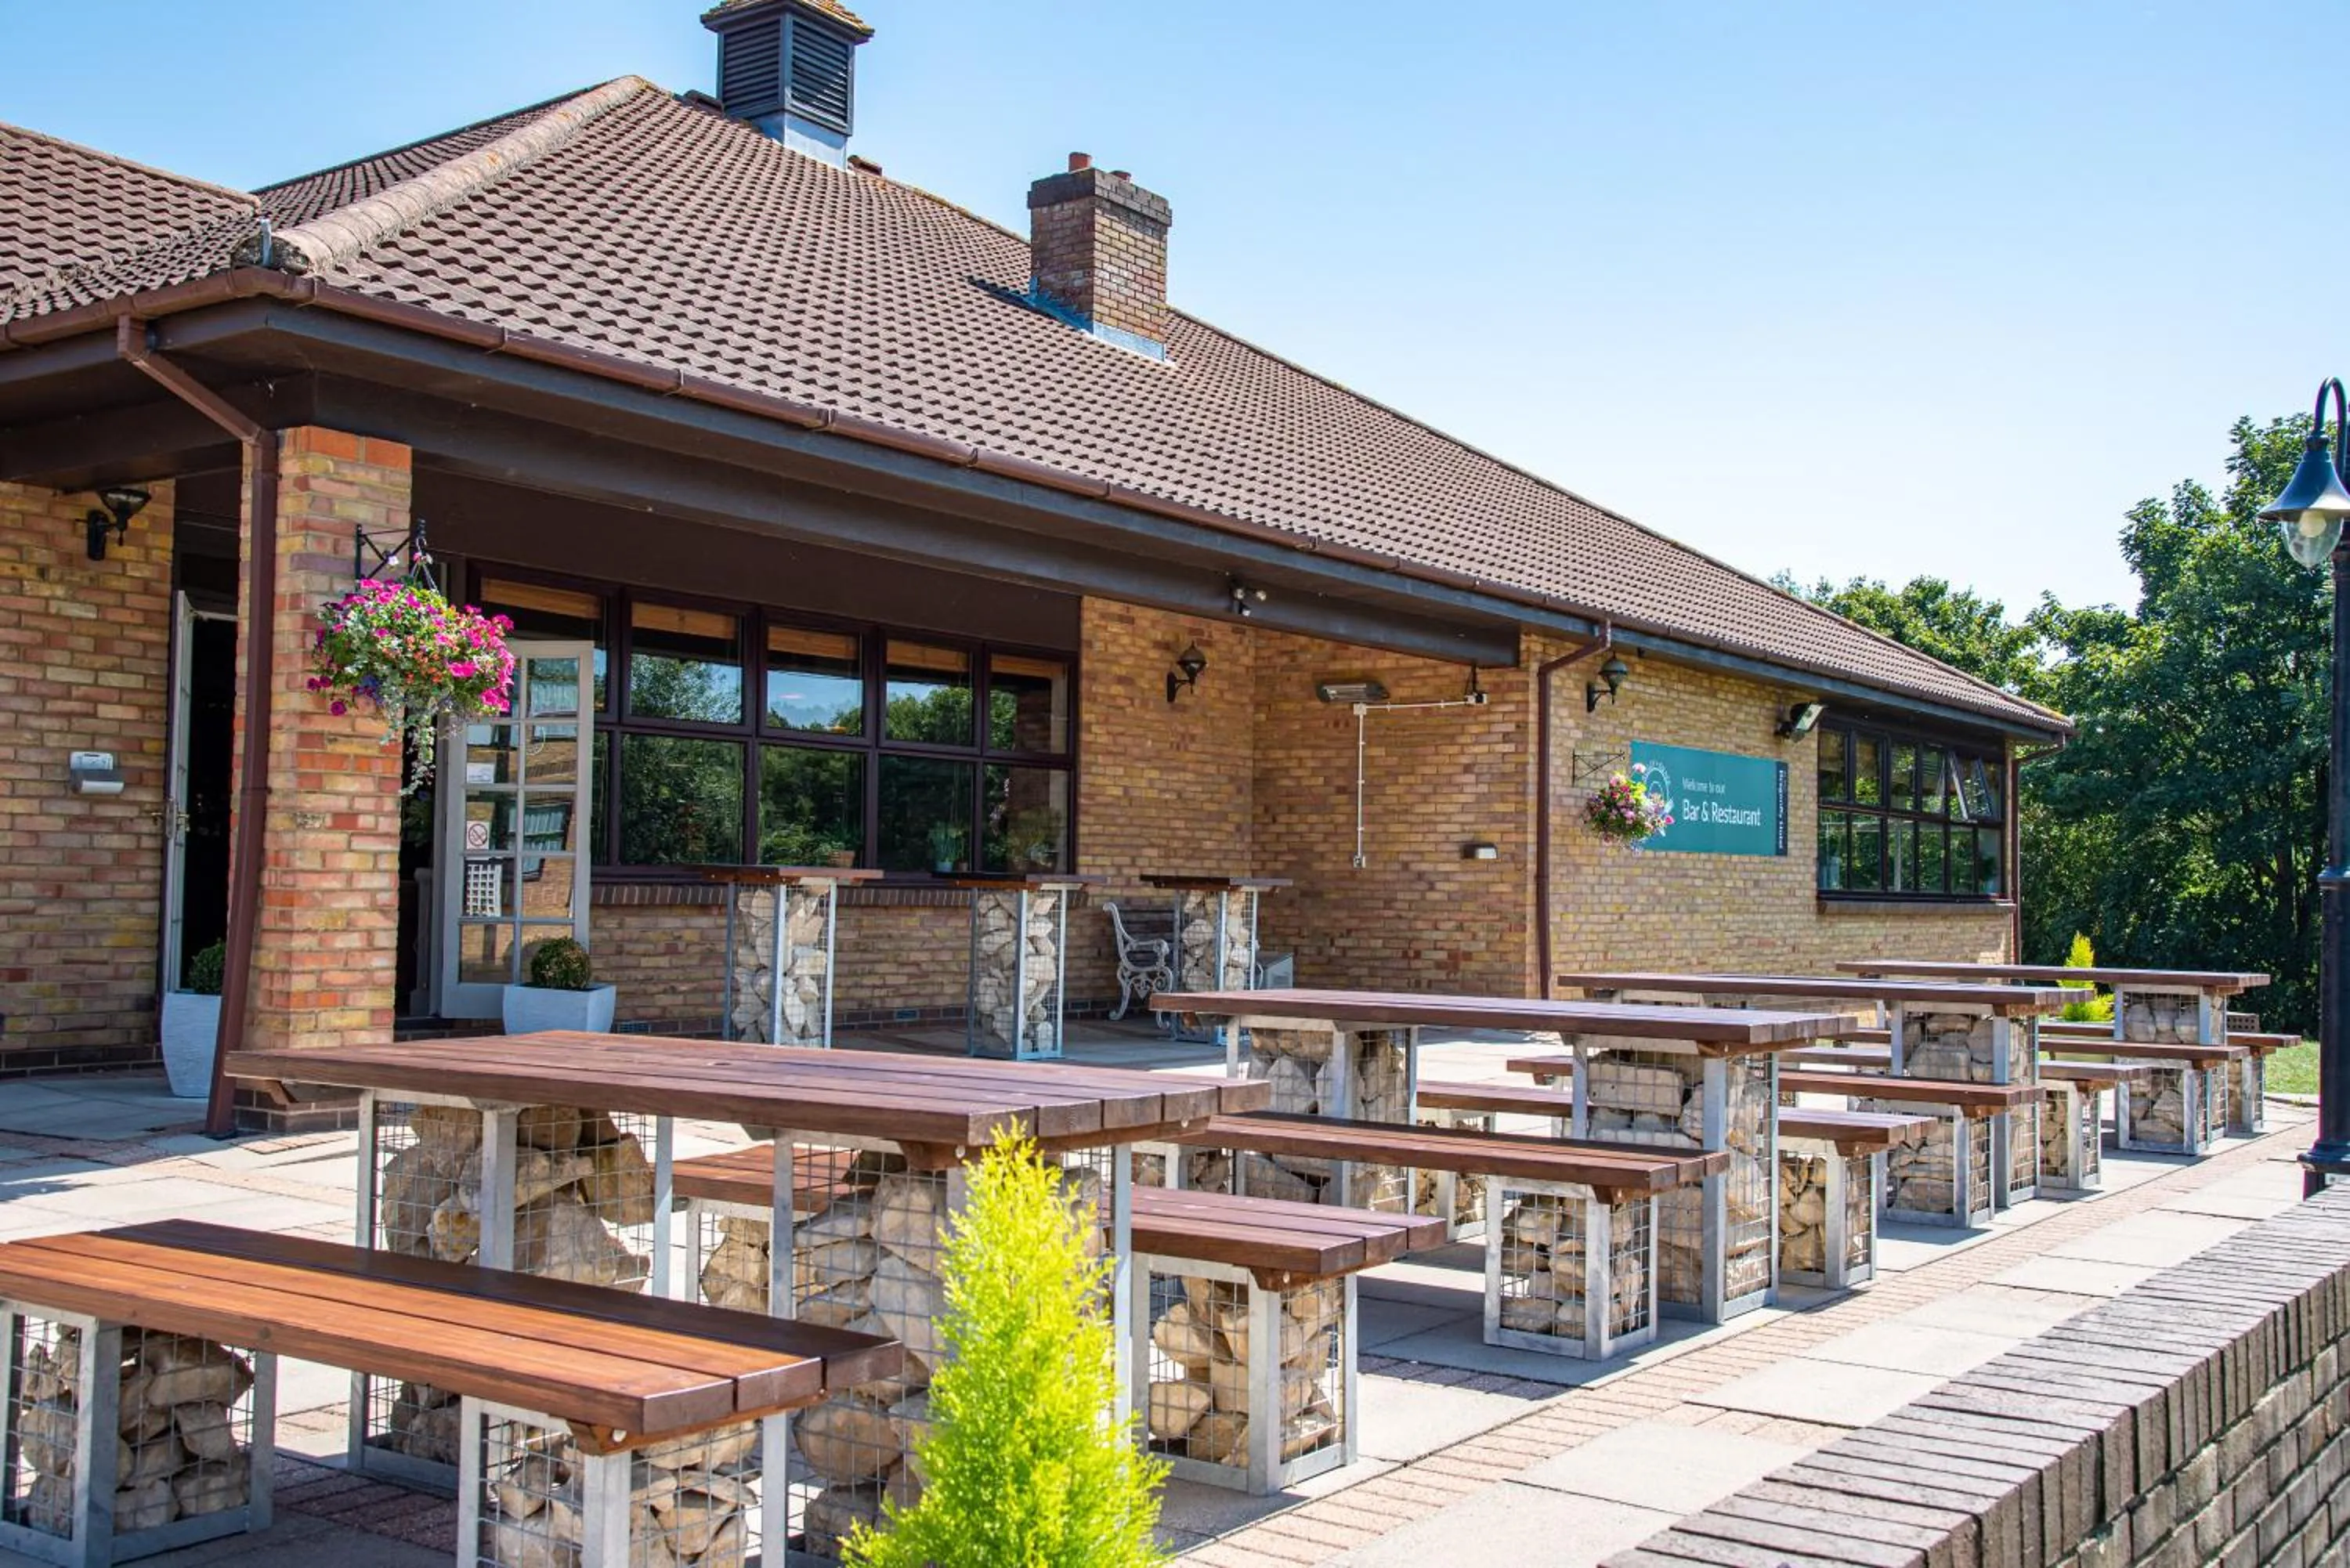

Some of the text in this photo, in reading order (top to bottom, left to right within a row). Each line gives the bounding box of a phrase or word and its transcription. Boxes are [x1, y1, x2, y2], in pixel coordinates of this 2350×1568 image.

[1682, 776, 1708, 793] Welcome
[1683, 799, 1760, 826] Bar & Restaurant
